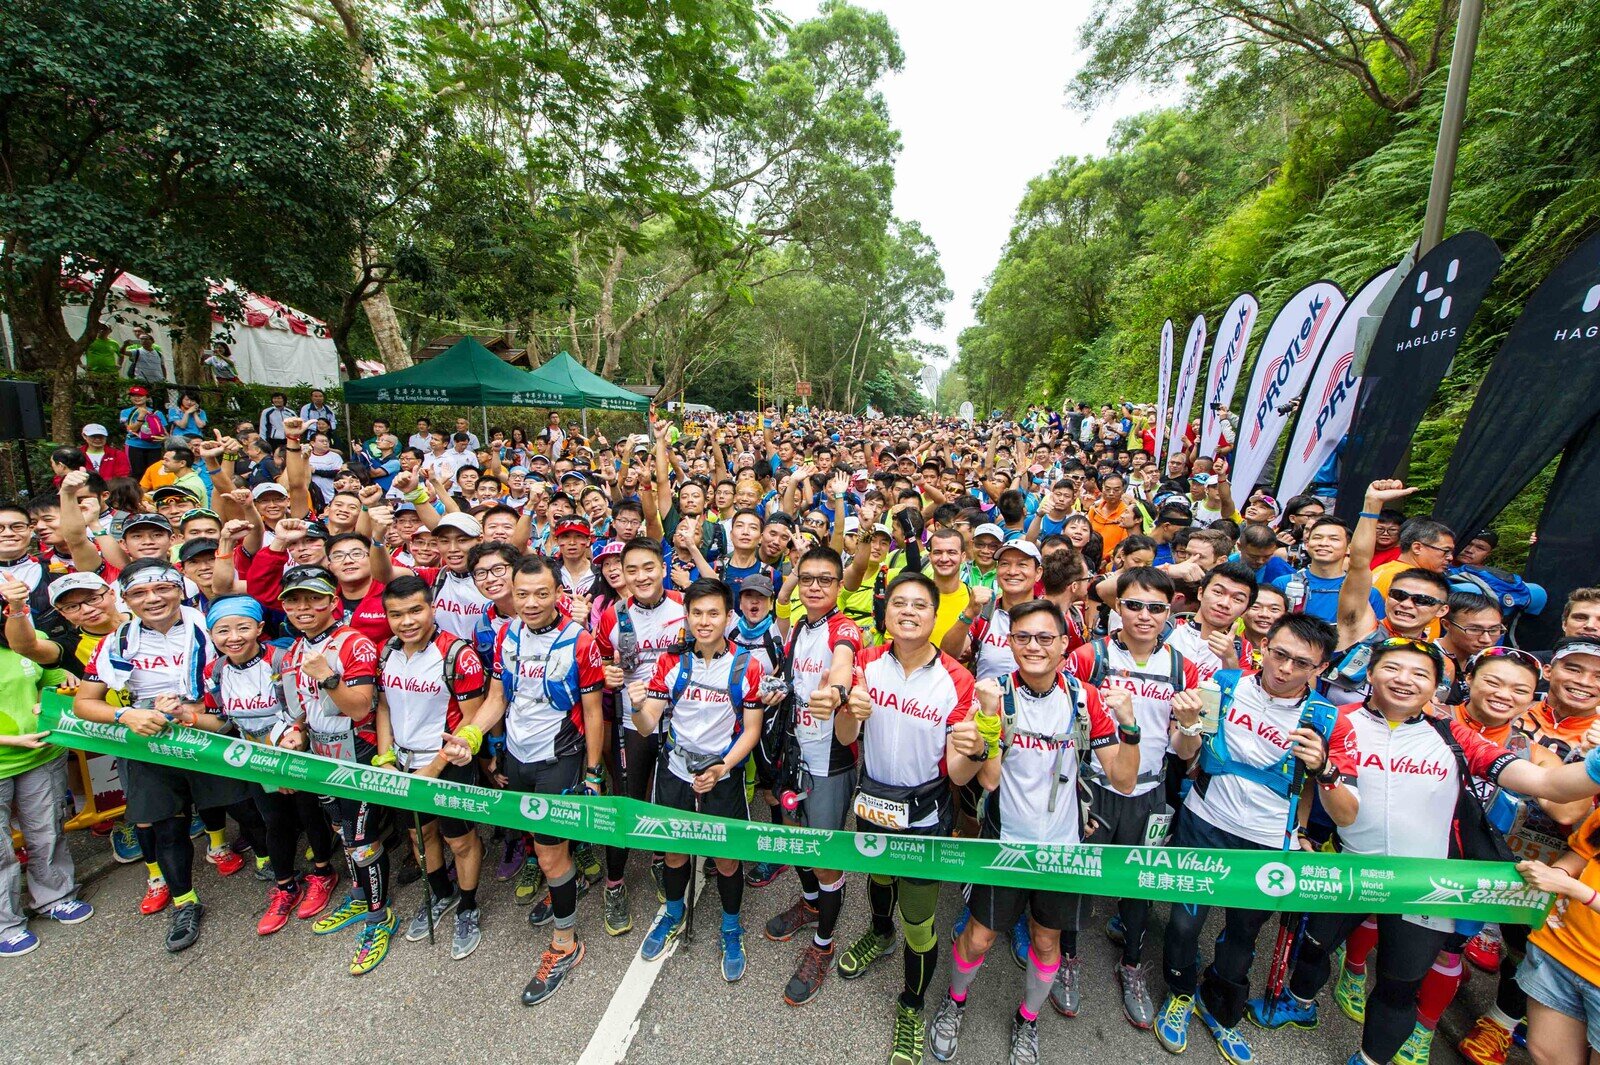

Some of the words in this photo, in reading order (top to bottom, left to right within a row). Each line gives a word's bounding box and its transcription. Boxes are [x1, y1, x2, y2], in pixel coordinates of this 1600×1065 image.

[1396, 327, 1457, 352] HAGLÖFS
[1257, 292, 1325, 431] PROTrek
[436, 598, 462, 615] AIA
[404, 676, 441, 696] Vitality
[869, 687, 898, 711] AIA
[901, 697, 942, 728] Vitality
[176, 727, 212, 751] Vitality
[1011, 732, 1043, 751] AIA
[148, 742, 198, 762] 健康程式
[250, 752, 280, 768] OXFAM
[288, 764, 308, 774] Without
[1390, 756, 1448, 782] Vitality
[360, 770, 411, 791] OXFAM
[359, 782, 409, 797] TRAILWALKER
[433, 791, 491, 815] 健康程式
[884, 802, 904, 812] 2015
[550, 807, 581, 821] OXFAM
[594, 812, 609, 820] World
[857, 803, 899, 830] 0455
[594, 818, 616, 827] Without
[594, 824, 616, 833] Poverty
[670, 819, 727, 834] OXFAM
[671, 831, 727, 843] TRAILWALKER
[757, 835, 821, 857] 健康程式
[890, 840, 925, 853] OXFAM
[940, 849, 966, 858] Without
[941, 842, 959, 850] World
[890, 852, 907, 862] Hong
[907, 854, 923, 863] Kong
[940, 856, 966, 867] Poverty
[1035, 852, 1102, 871] OXFAM
[1125, 849, 1173, 869] AIA
[1177, 851, 1231, 881] Vitality
[1035, 864, 1102, 878] TRAILWALKER
[1301, 864, 1342, 880] 樂施會
[1360, 868, 1396, 880] 無窮世界
[1137, 870, 1215, 895] 健康程式
[1299, 879, 1343, 894] OXFAM
[1360, 880, 1384, 890] World
[1299, 891, 1318, 901] Hong
[1318, 892, 1338, 901] Kong
[1361, 889, 1391, 898] Without
[1471, 888, 1550, 904] OXFAM
[1467, 897, 1546, 911] TRAILWALKER
